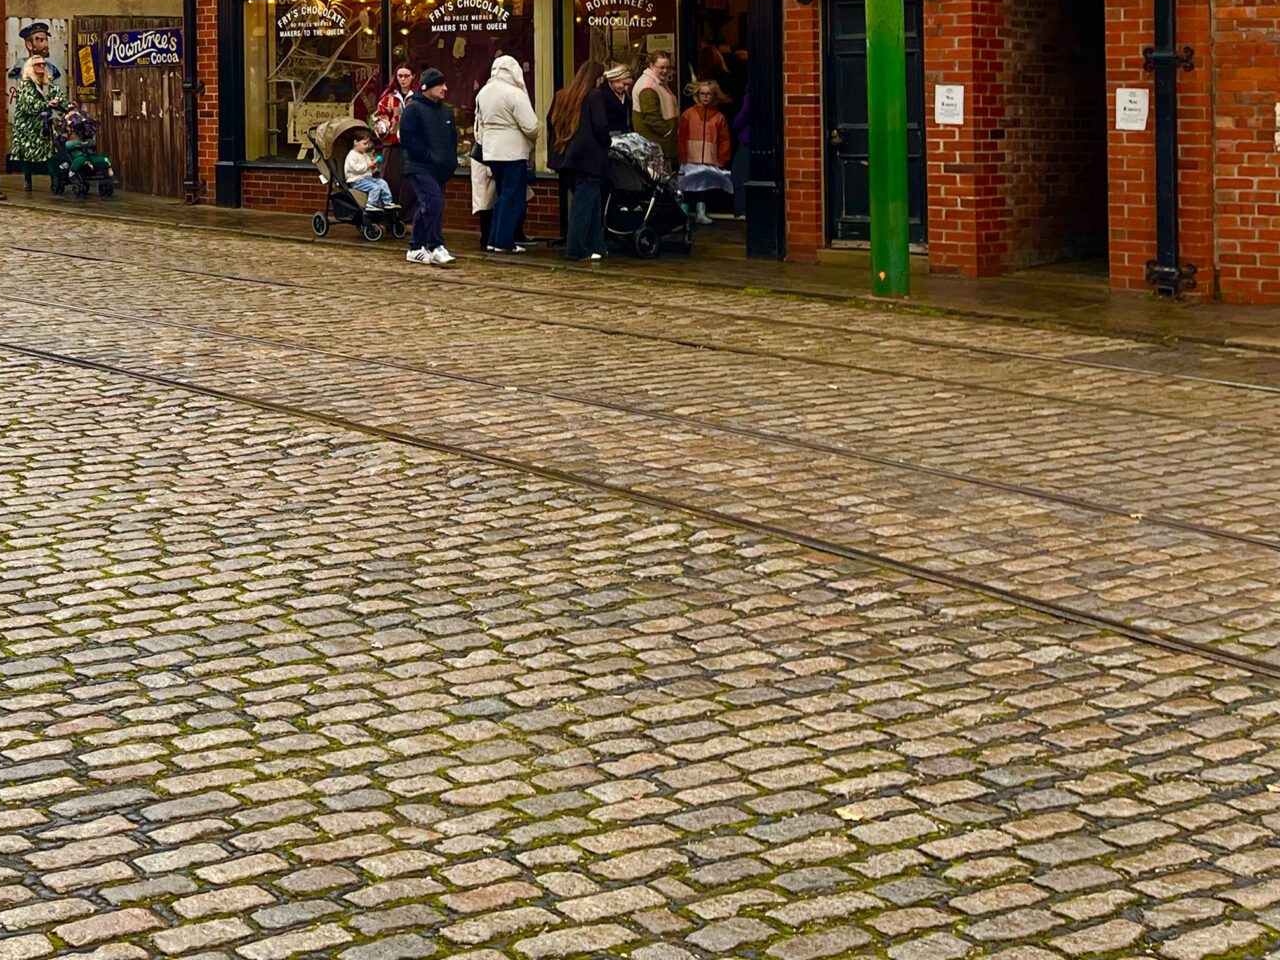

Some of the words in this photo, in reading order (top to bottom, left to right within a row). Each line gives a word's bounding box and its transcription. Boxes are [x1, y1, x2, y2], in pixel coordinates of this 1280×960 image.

[277, 7, 299, 28] FRY'S
[301, 5, 347, 27] CHOCOLATE
[429, 0, 454, 23] FRY'S
[431, 24, 456, 32] MAKERS
[486, 23, 508, 31] QUEEN
[588, 16, 653, 28] CHOCOLATES
[279, 29, 300, 38] MAKERS
[303, 29, 311, 37] TO
[107, 30, 178, 64] Rowntree's
